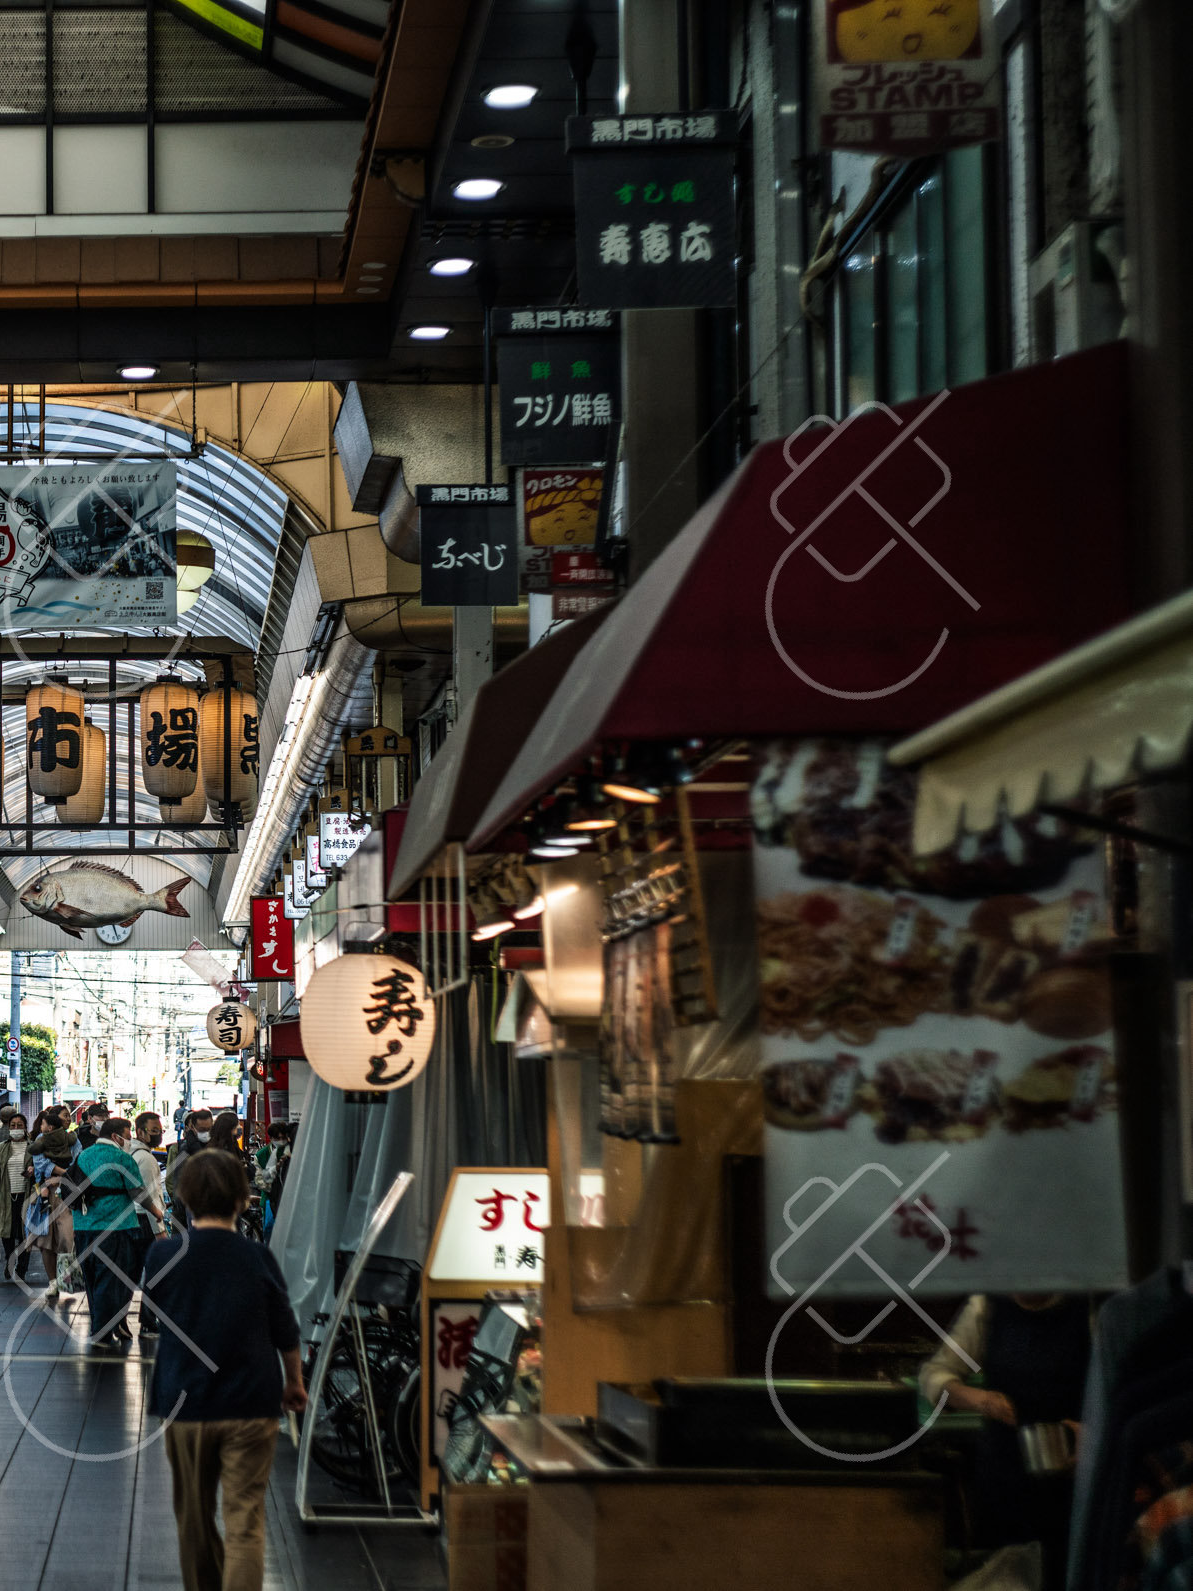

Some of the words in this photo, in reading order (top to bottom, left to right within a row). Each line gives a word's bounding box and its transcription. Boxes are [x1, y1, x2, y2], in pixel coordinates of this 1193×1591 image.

[841, 62, 965, 86] フレッシュ
[829, 81, 985, 112] STAMP
[591, 116, 716, 142] 黒門市場
[511, 310, 612, 330] 黒門市場
[514, 393, 612, 427] フジノ鮮魚
[32, 473, 160, 485] 今後ともよろしくお願い致します
[526, 474, 577, 494] クロモン
[431, 487, 509, 502] 黒門市場
[258, 900, 288, 975] さかえすし
[215, 1004, 243, 1047] 寿司
[474, 1188, 546, 1232] すし
